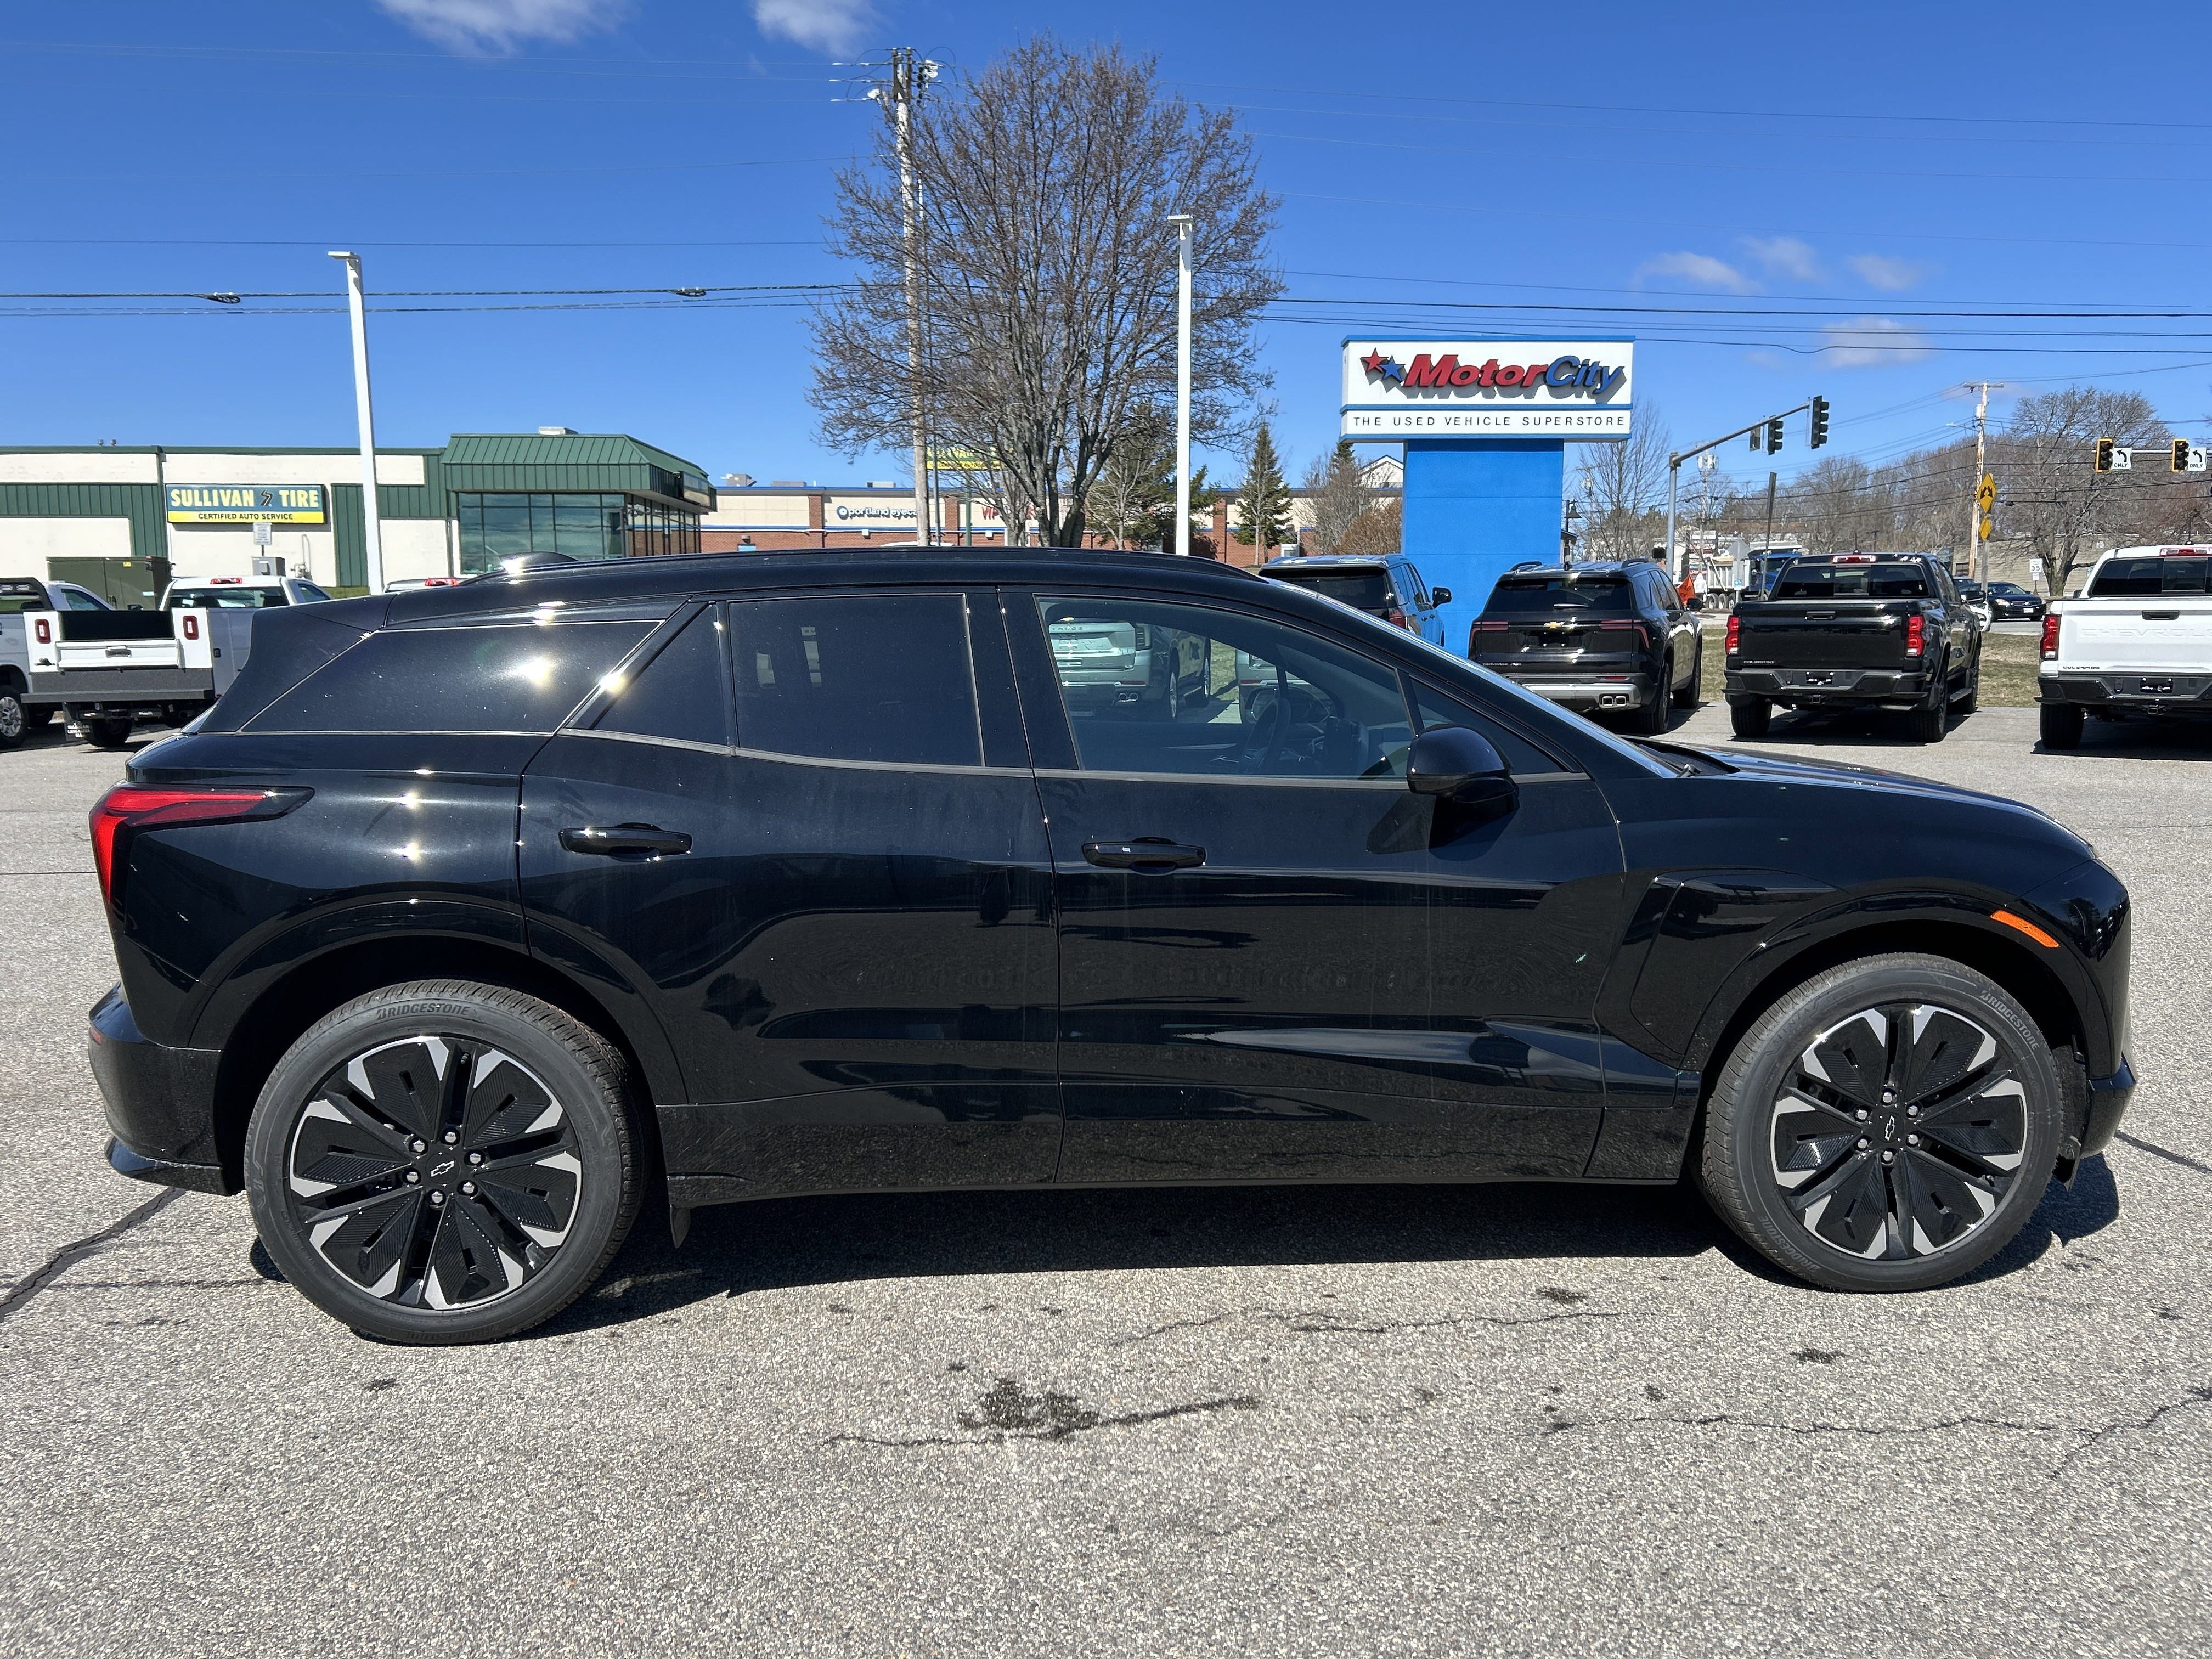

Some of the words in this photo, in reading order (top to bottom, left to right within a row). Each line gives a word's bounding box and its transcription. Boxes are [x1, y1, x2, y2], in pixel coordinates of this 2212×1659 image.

[1403, 353, 1625, 394] MotorCity
[1353, 416, 1381, 426] THE
[1393, 416, 1435, 426] USED
[1445, 416, 1510, 426] VEHICLE
[1522, 416, 1625, 426] SUPERSTORE
[171, 489, 255, 507] SULLIVAN
[279, 490, 319, 507] TIRE
[848, 507, 889, 517] portland
[890, 509, 918, 517] eyeca
[2081, 628, 2212, 638] CHEVROL
[376, 1002, 471, 1020] BRIDGESTONE
[1978, 990, 2040, 1051] BRIDGESTONE
[1757, 1215, 1822, 1273] BRIDGESTONE
